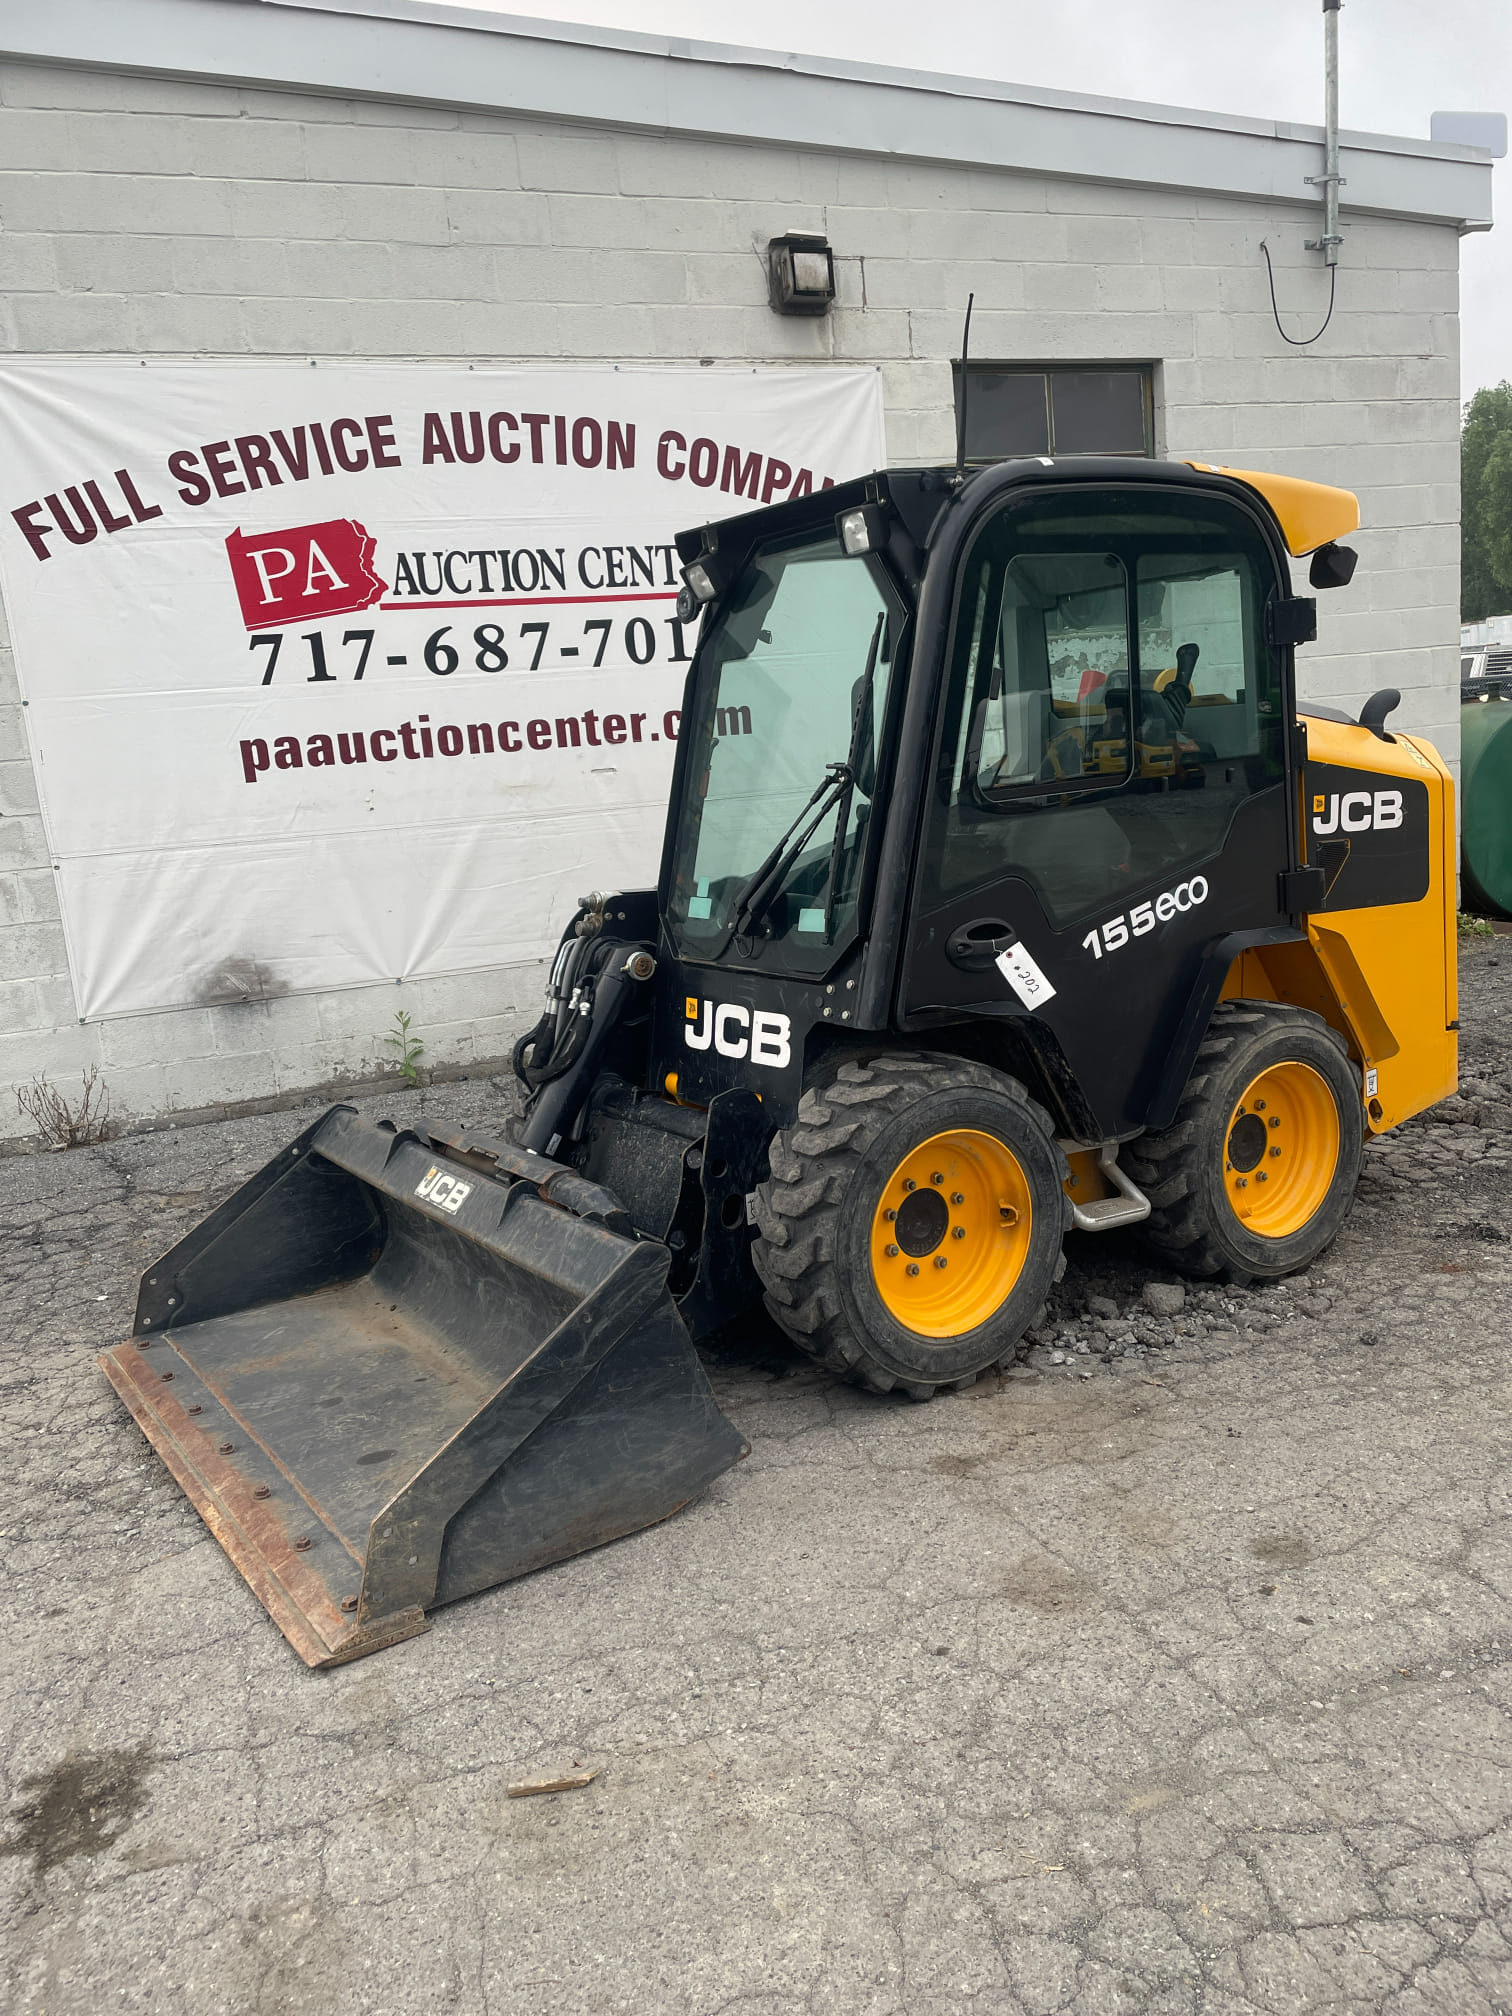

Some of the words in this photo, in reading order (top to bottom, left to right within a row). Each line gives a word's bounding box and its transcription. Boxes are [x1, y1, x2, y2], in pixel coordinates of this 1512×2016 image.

[11, 469, 163, 562] FULL
[168, 415, 401, 506] SERVICE
[422, 411, 636, 471] AUCTION
[657, 430, 835, 504] COMPA
[246, 539, 350, 605] PA
[393, 548, 566, 596] AUCTION
[239, 705, 753, 784] paauctioncenter.cm
[1312, 790, 1403, 835] JCB
[684, 1000, 791, 1069] JCB
[413, 1171, 472, 1212] JCB
